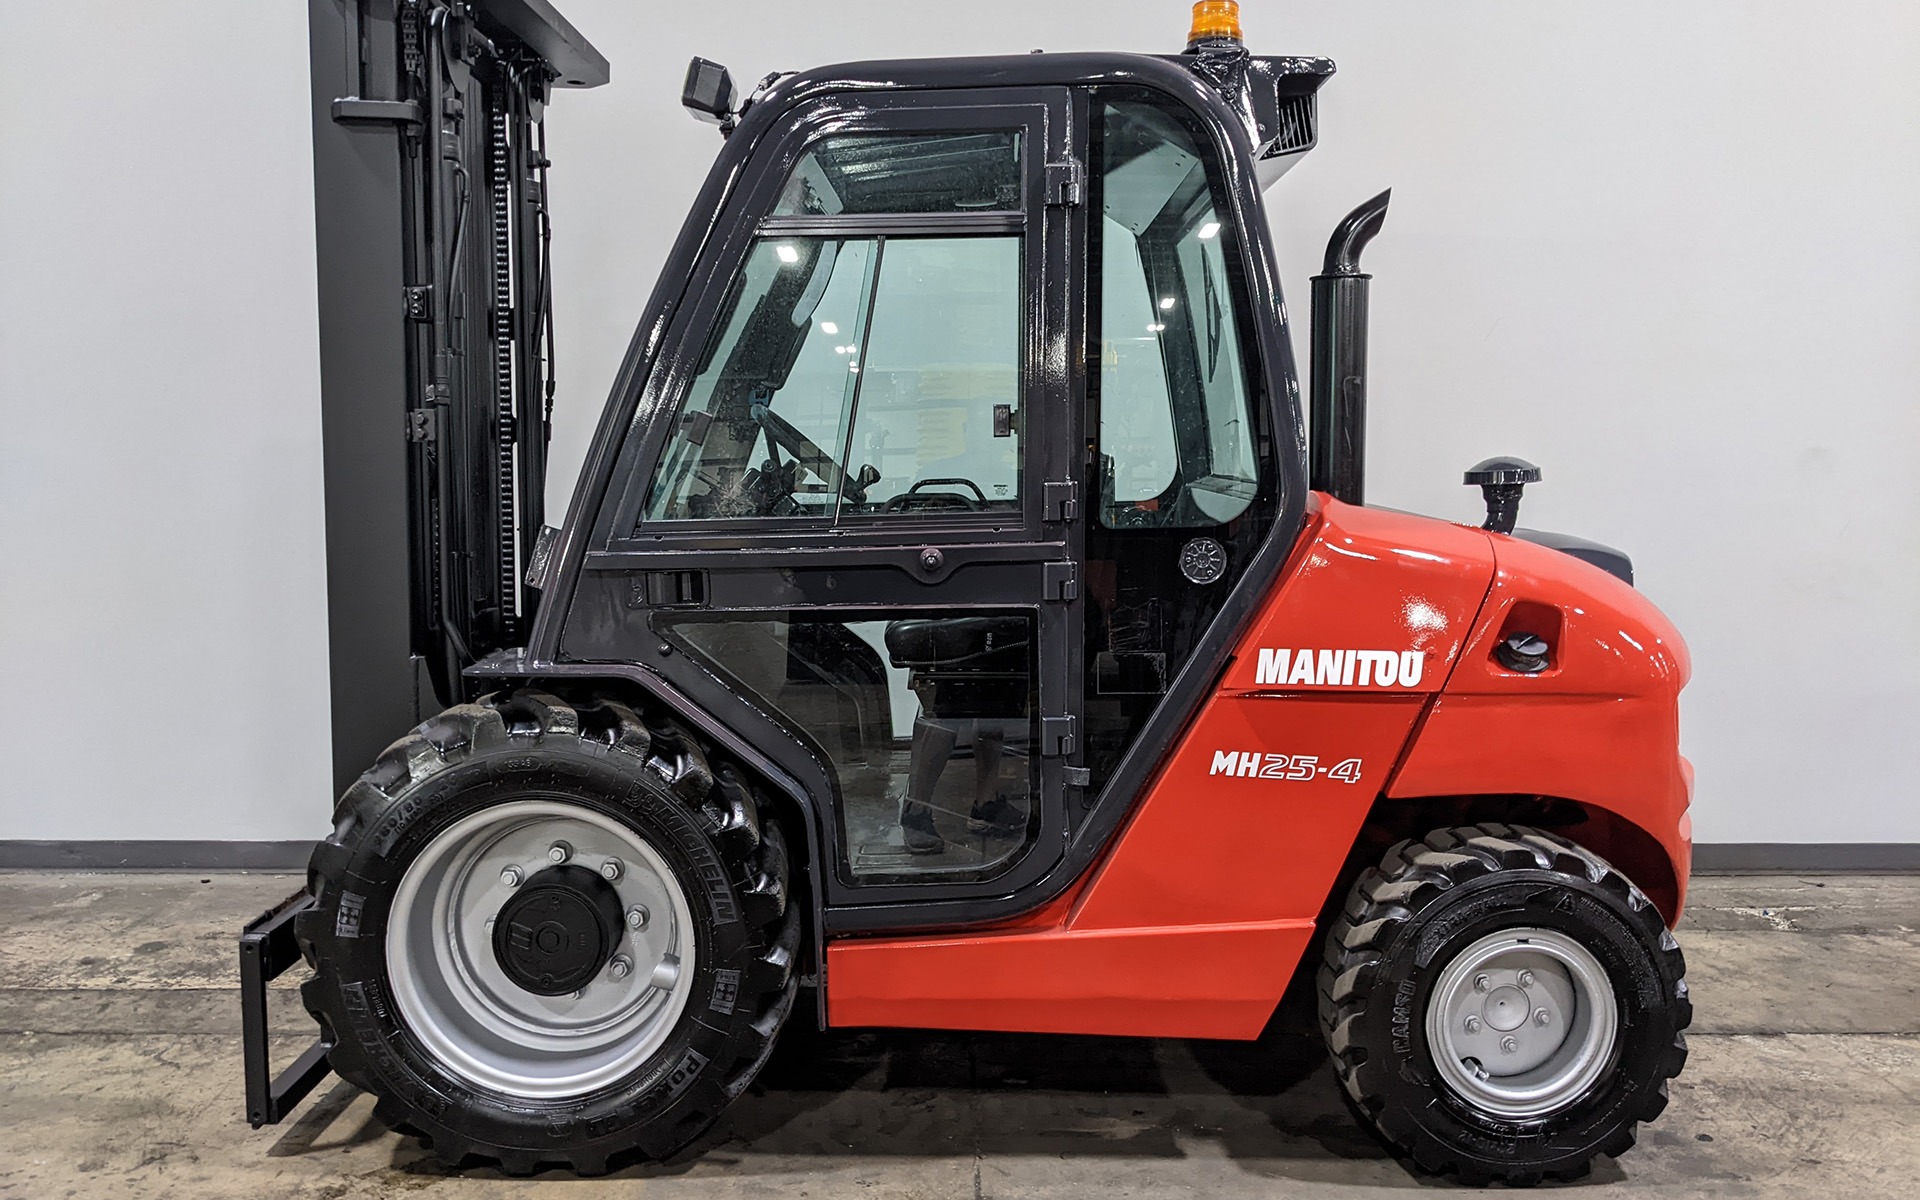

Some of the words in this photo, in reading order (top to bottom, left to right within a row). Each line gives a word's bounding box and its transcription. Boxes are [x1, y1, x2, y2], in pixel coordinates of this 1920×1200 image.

[1255, 648, 1424, 687] MANITOU
[1209, 750, 1362, 784] MH25-4
[653, 805, 738, 922] MICHELIN
